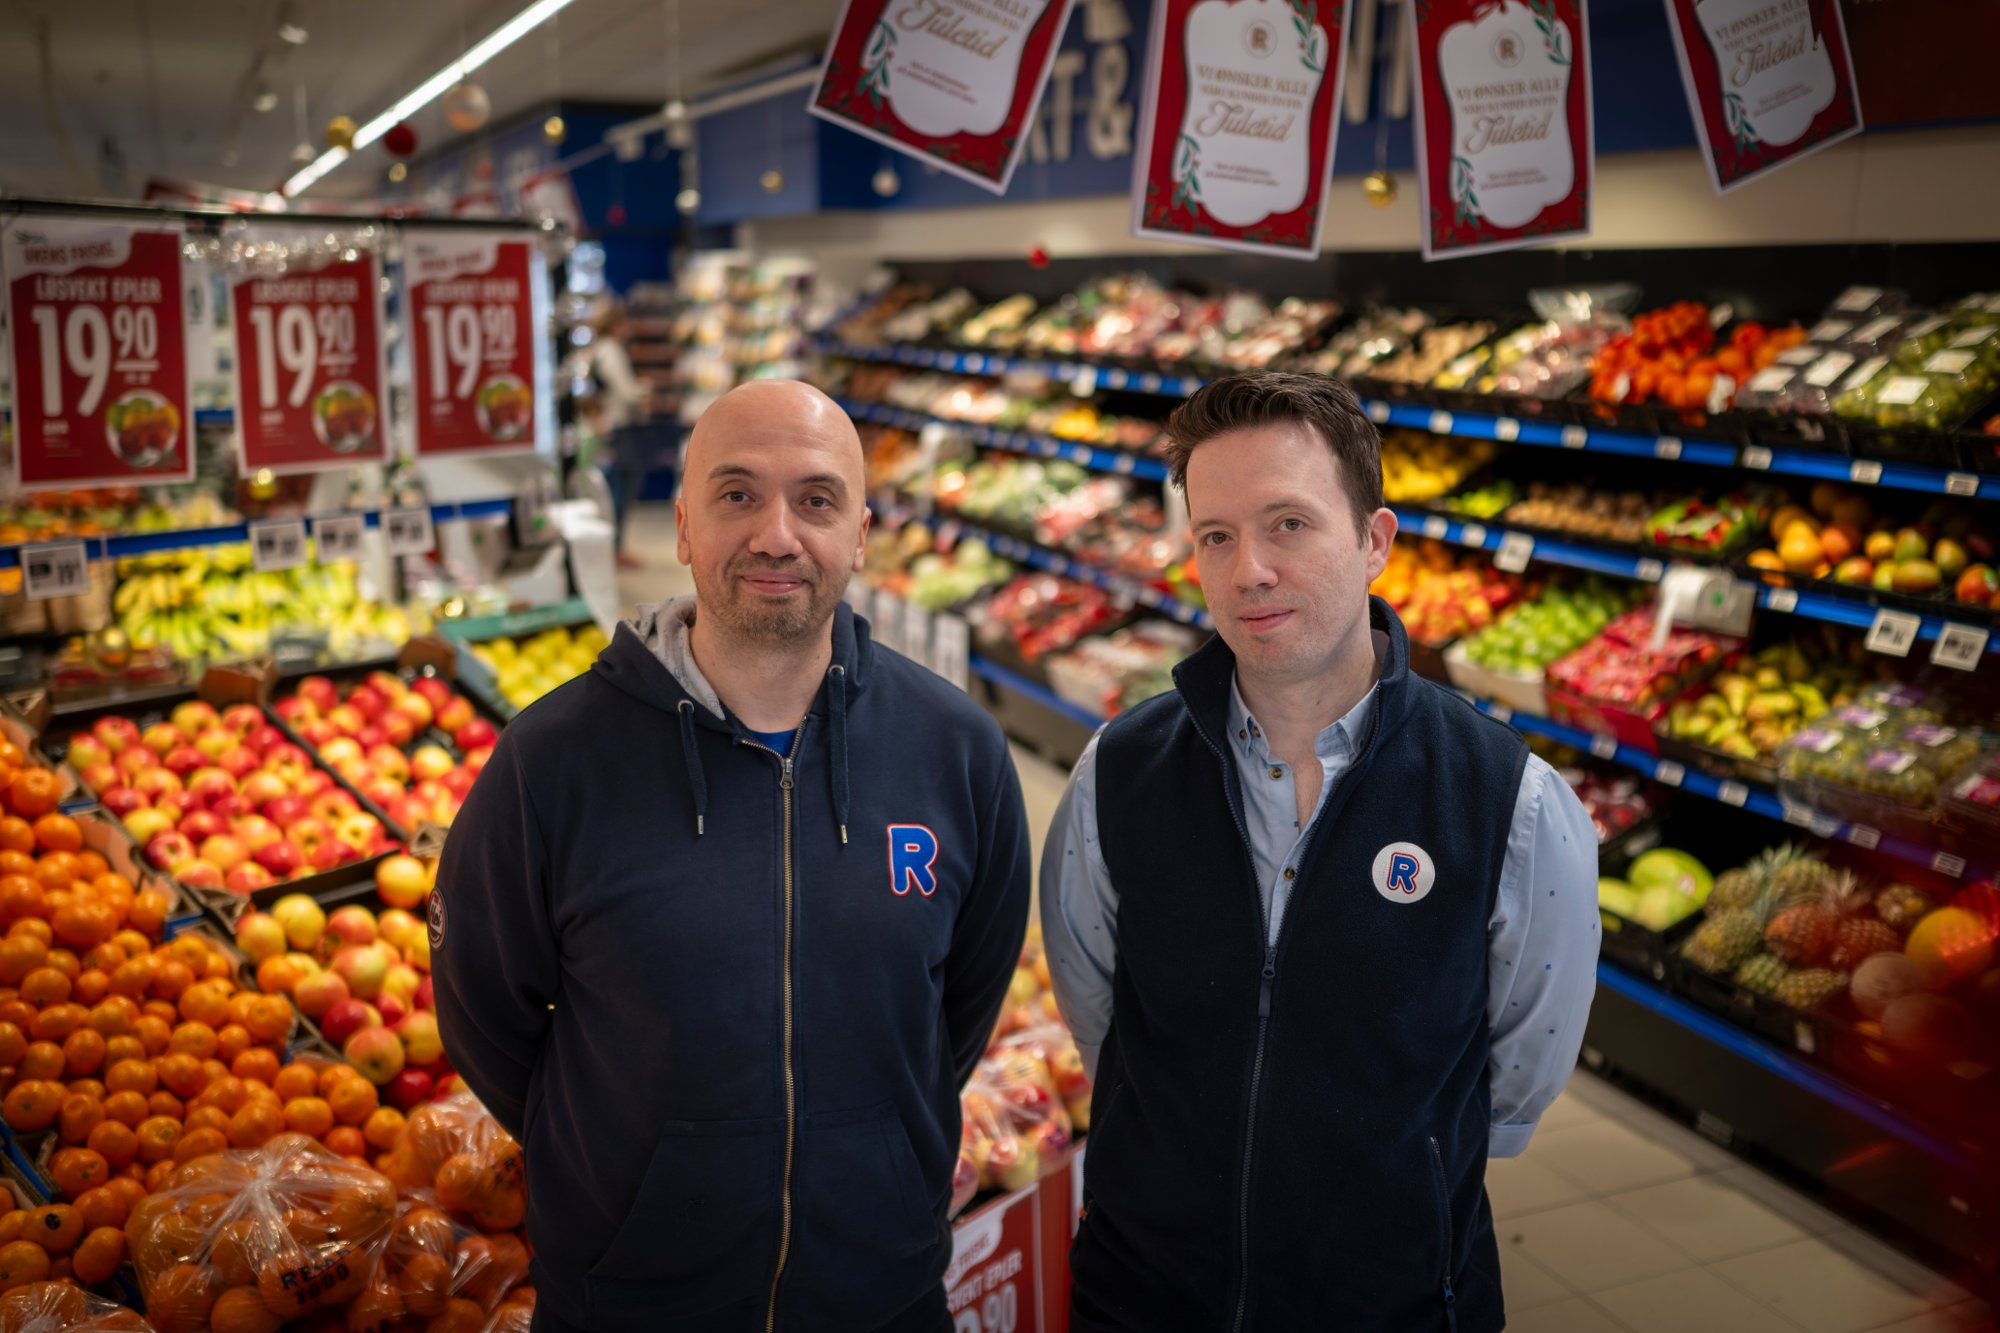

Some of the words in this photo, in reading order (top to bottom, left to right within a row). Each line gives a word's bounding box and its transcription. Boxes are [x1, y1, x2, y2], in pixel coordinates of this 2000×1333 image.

[1731, 27, 1807, 88] Juletid
[1194, 100, 1296, 142] Juletid
[1462, 110, 1553, 155] Juletid
[111, 276, 162, 303] EPLER
[32, 303, 111, 417] 19
[113, 304, 158, 359] 90
[249, 304, 317, 407] 19
[317, 304, 355, 353] 90
[422, 304, 482, 399] 19
[481, 304, 517, 350] 90
[886, 823, 940, 898] R
[1387, 852, 1420, 894] R
[984, 1248, 1022, 1291] EPLER
